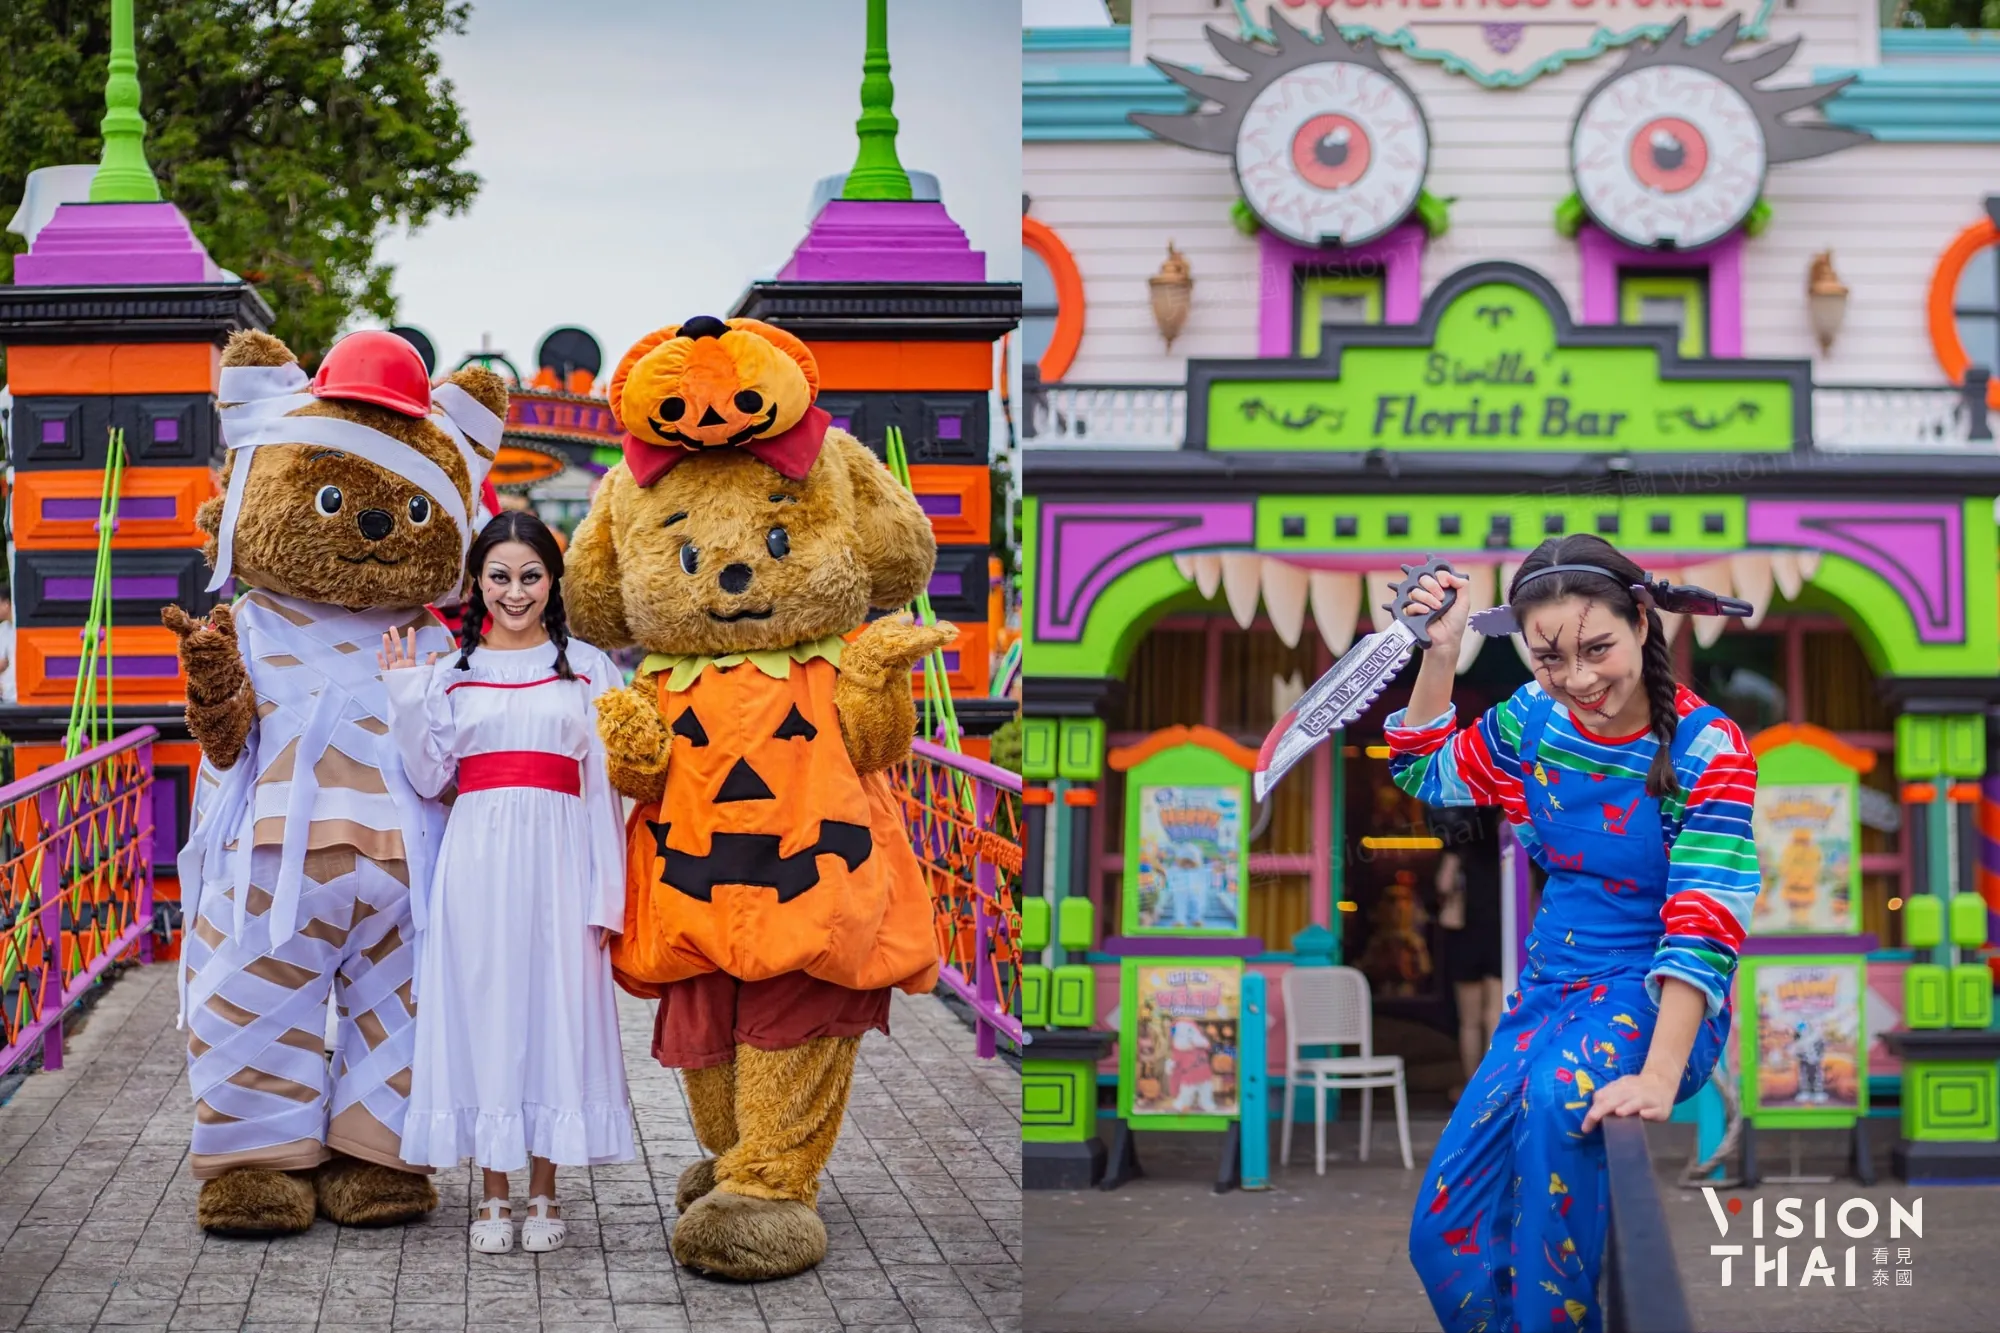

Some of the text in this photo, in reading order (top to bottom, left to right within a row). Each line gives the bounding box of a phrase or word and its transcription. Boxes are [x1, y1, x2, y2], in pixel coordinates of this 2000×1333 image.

[1372, 394, 1628, 437] Florist Bar
[1304, 636, 1403, 731] ZOMBIE KILLER
